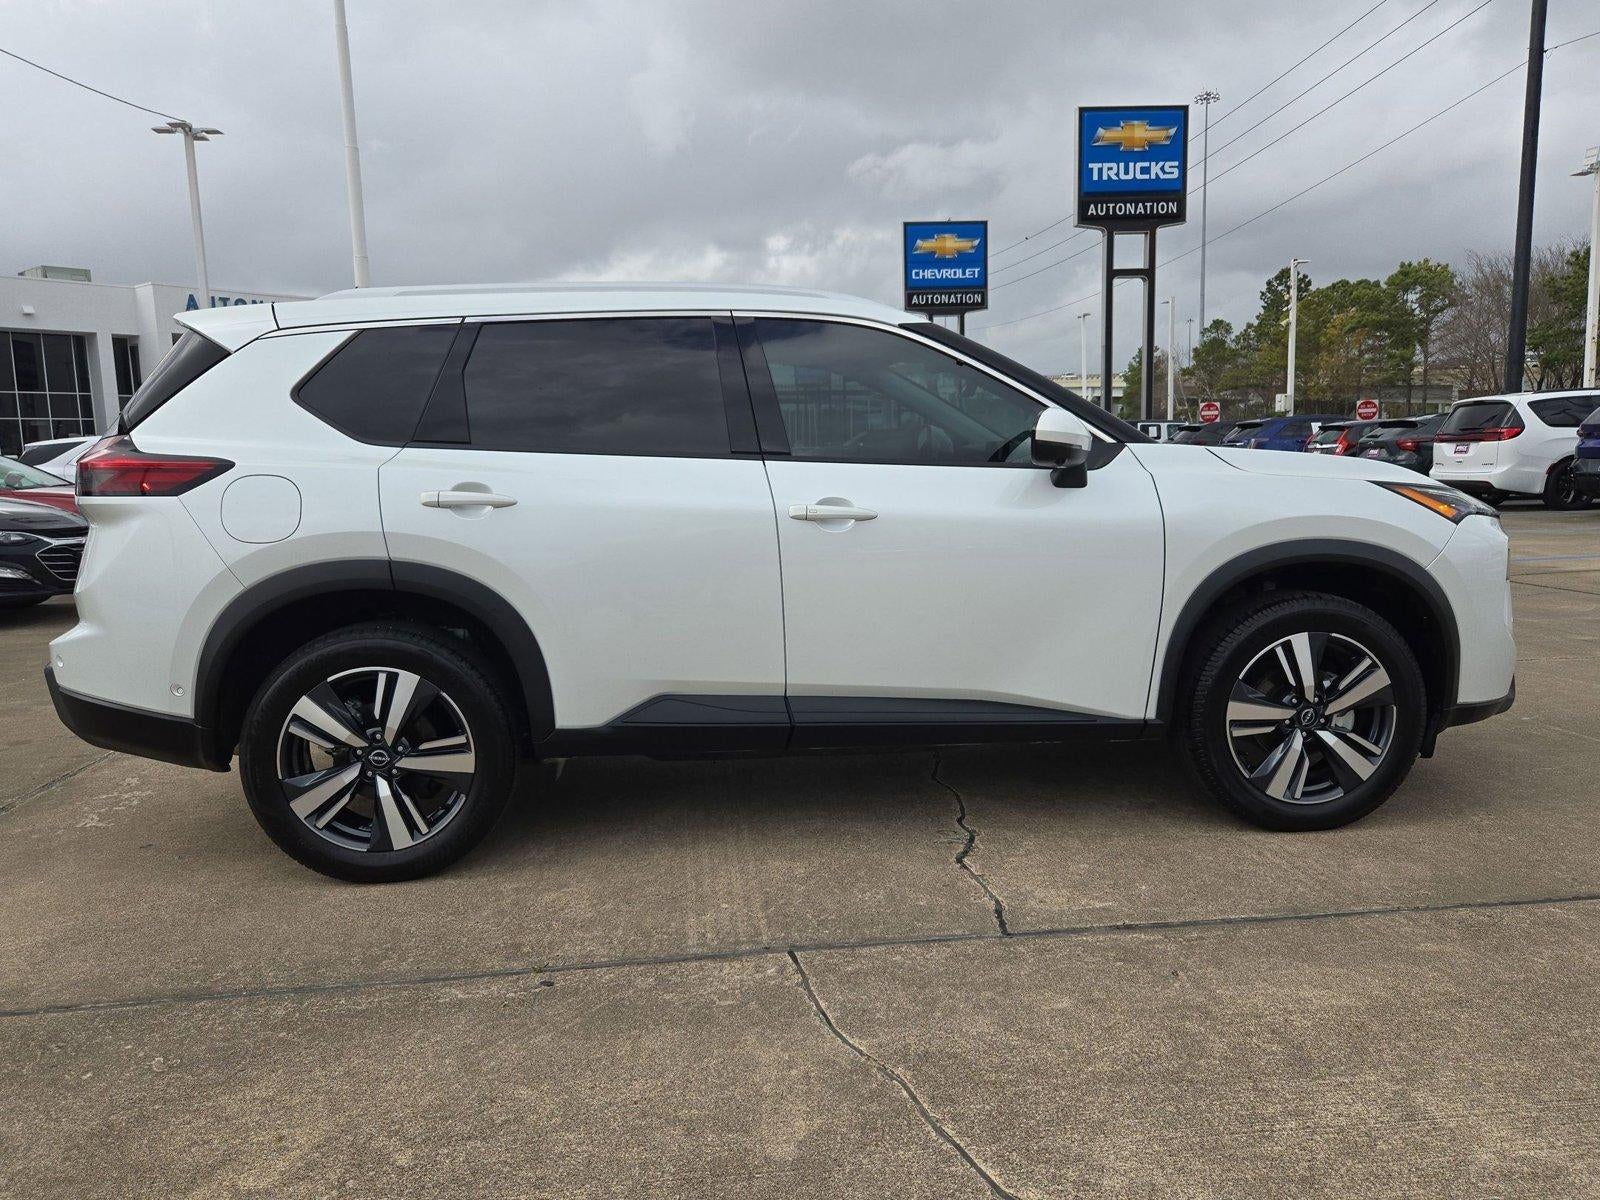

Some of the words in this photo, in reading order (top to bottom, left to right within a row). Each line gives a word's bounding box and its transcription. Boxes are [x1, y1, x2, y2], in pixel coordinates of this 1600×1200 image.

[1088, 161, 1179, 180] TRUCKS
[1087, 201, 1177, 216] AUTONATION
[911, 267, 981, 279] CHEVROLET
[911, 293, 982, 305] AUTONATION
